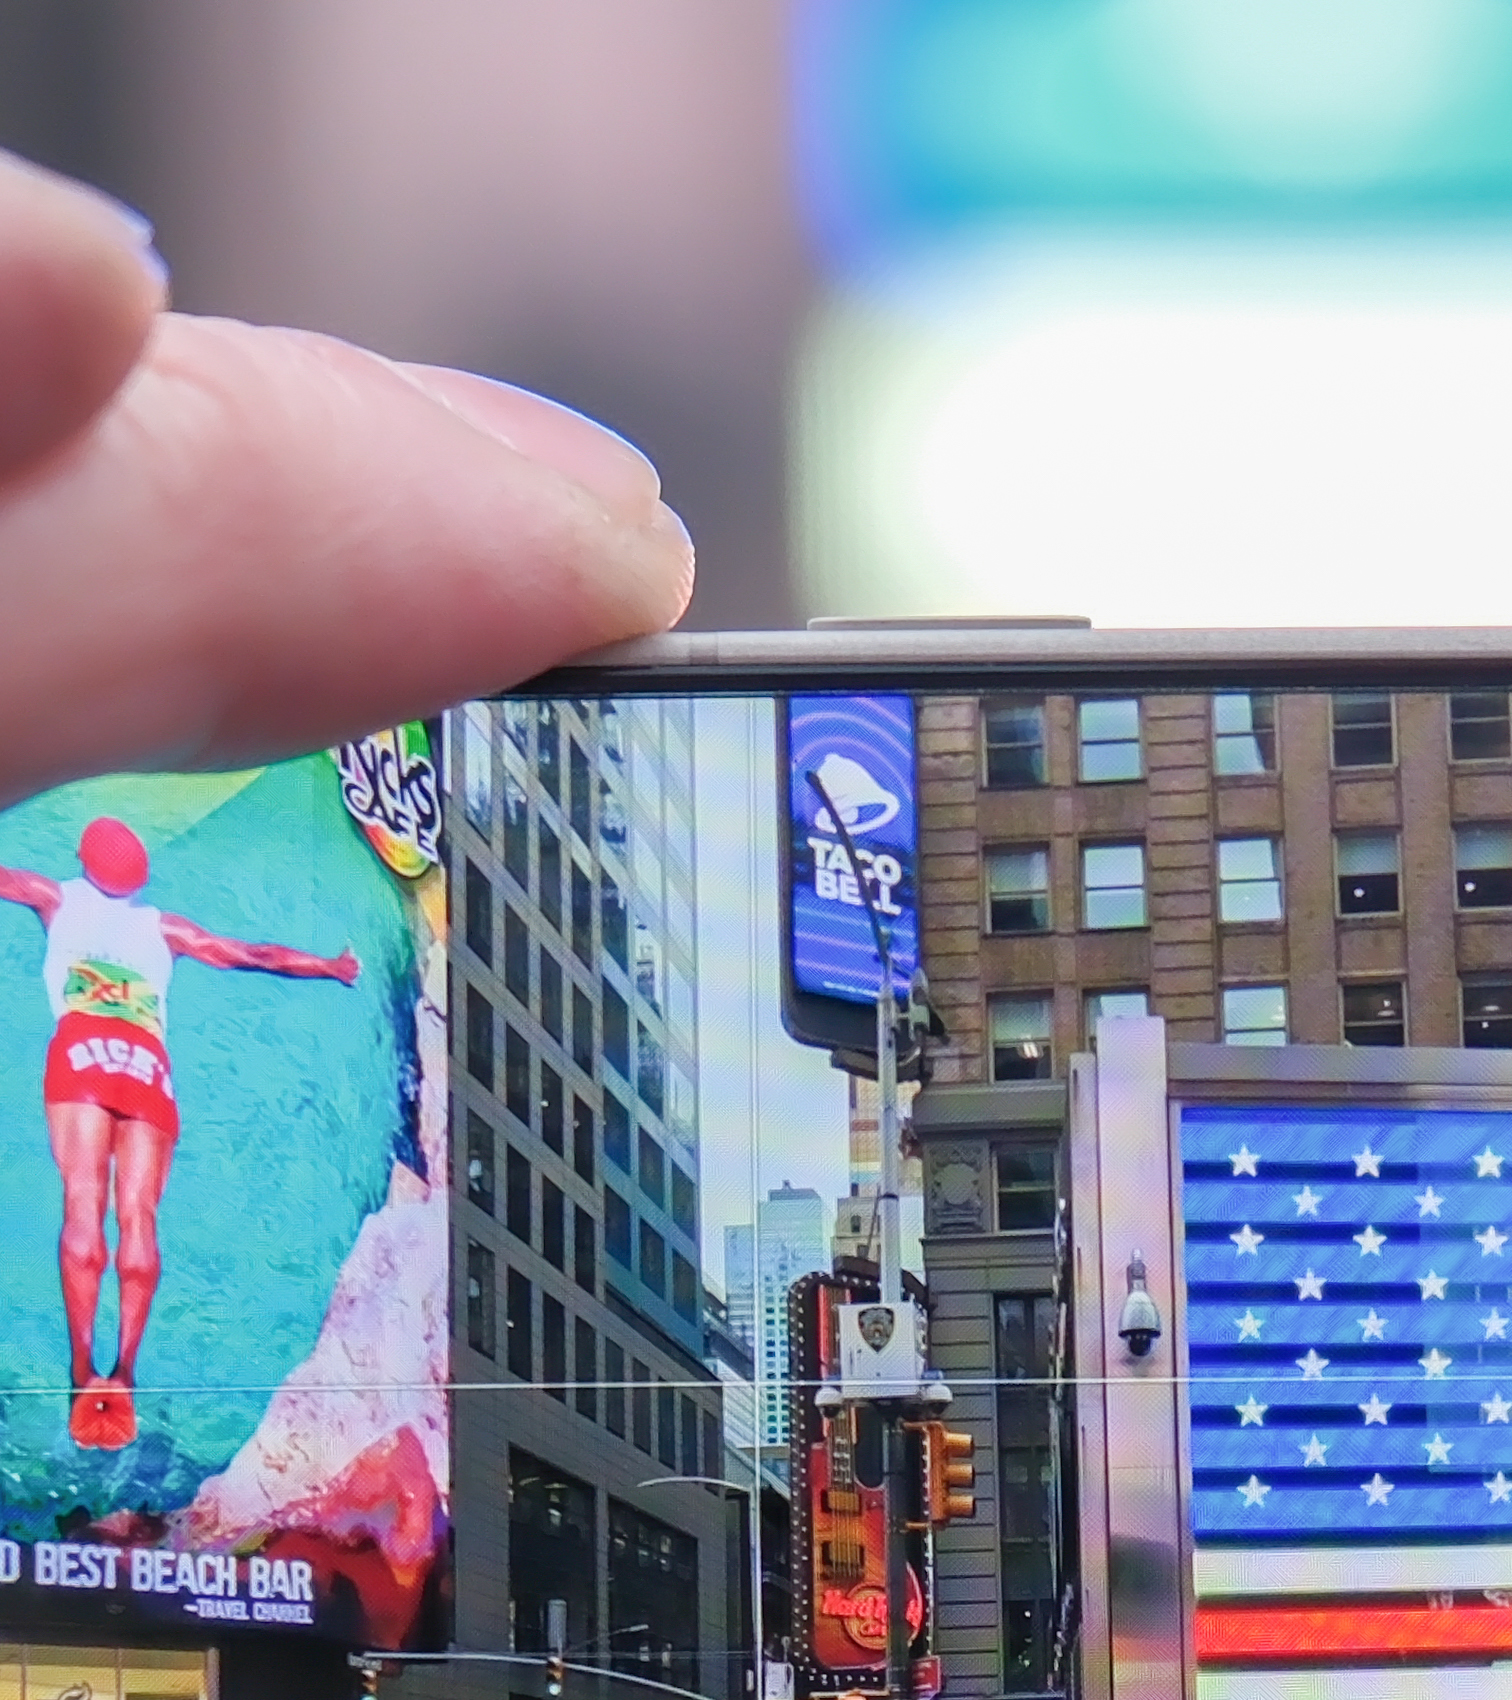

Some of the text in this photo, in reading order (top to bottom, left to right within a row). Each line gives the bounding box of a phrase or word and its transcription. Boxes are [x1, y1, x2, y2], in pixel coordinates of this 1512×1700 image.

[34, 1541, 122, 1589] BEST
[131, 1547, 238, 1598] BEACH
[249, 1556, 314, 1601] BAR
